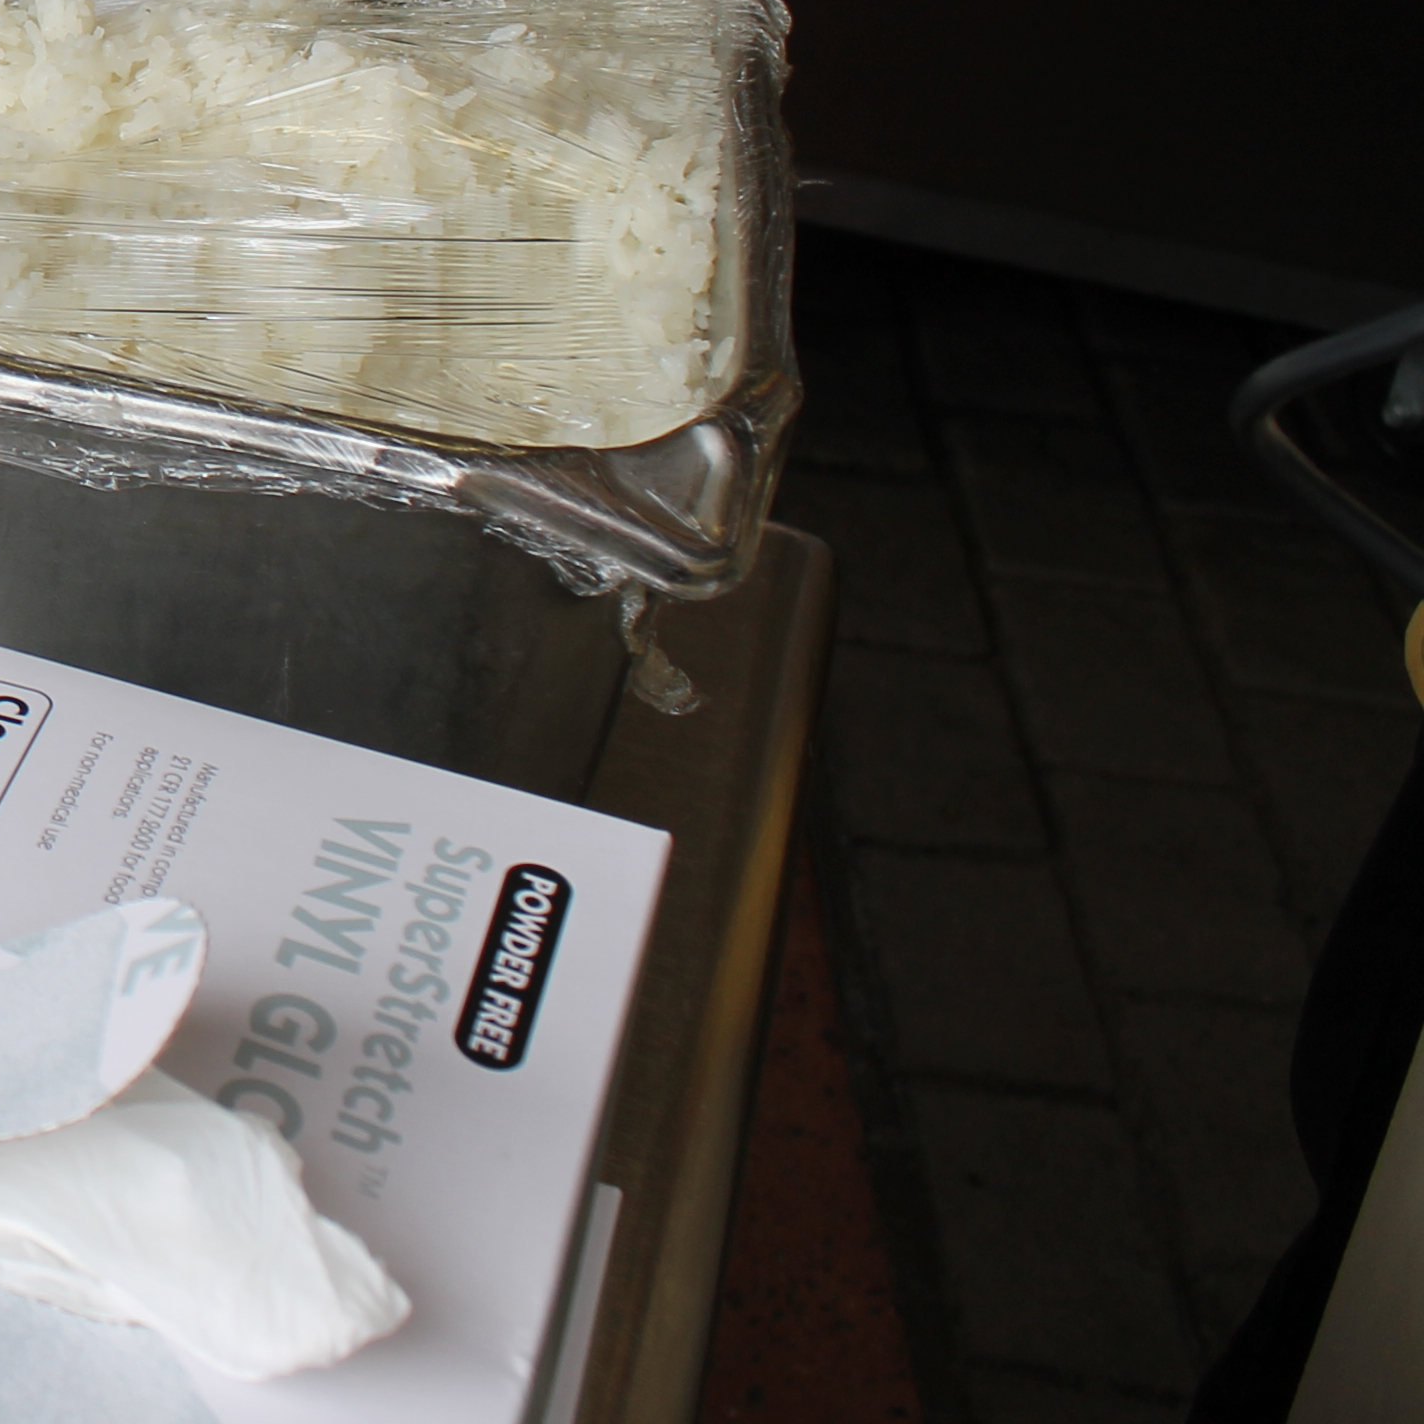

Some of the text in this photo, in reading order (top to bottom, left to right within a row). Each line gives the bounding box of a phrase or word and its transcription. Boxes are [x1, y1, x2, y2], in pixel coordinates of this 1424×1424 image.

[37, 730, 114, 851] For non-medical use
[111, 745, 160, 822] applications.
[158, 771, 184, 795] CFR
[169, 754, 192, 772] 21
[130, 794, 172, 852] 177.2600
[166, 762, 214, 844] Manufactured
[120, 850, 146, 872] for
[159, 844, 177, 857] in
[278, 815, 414, 991] VINYL
[466, 869, 558, 1061] POWDER FREE
